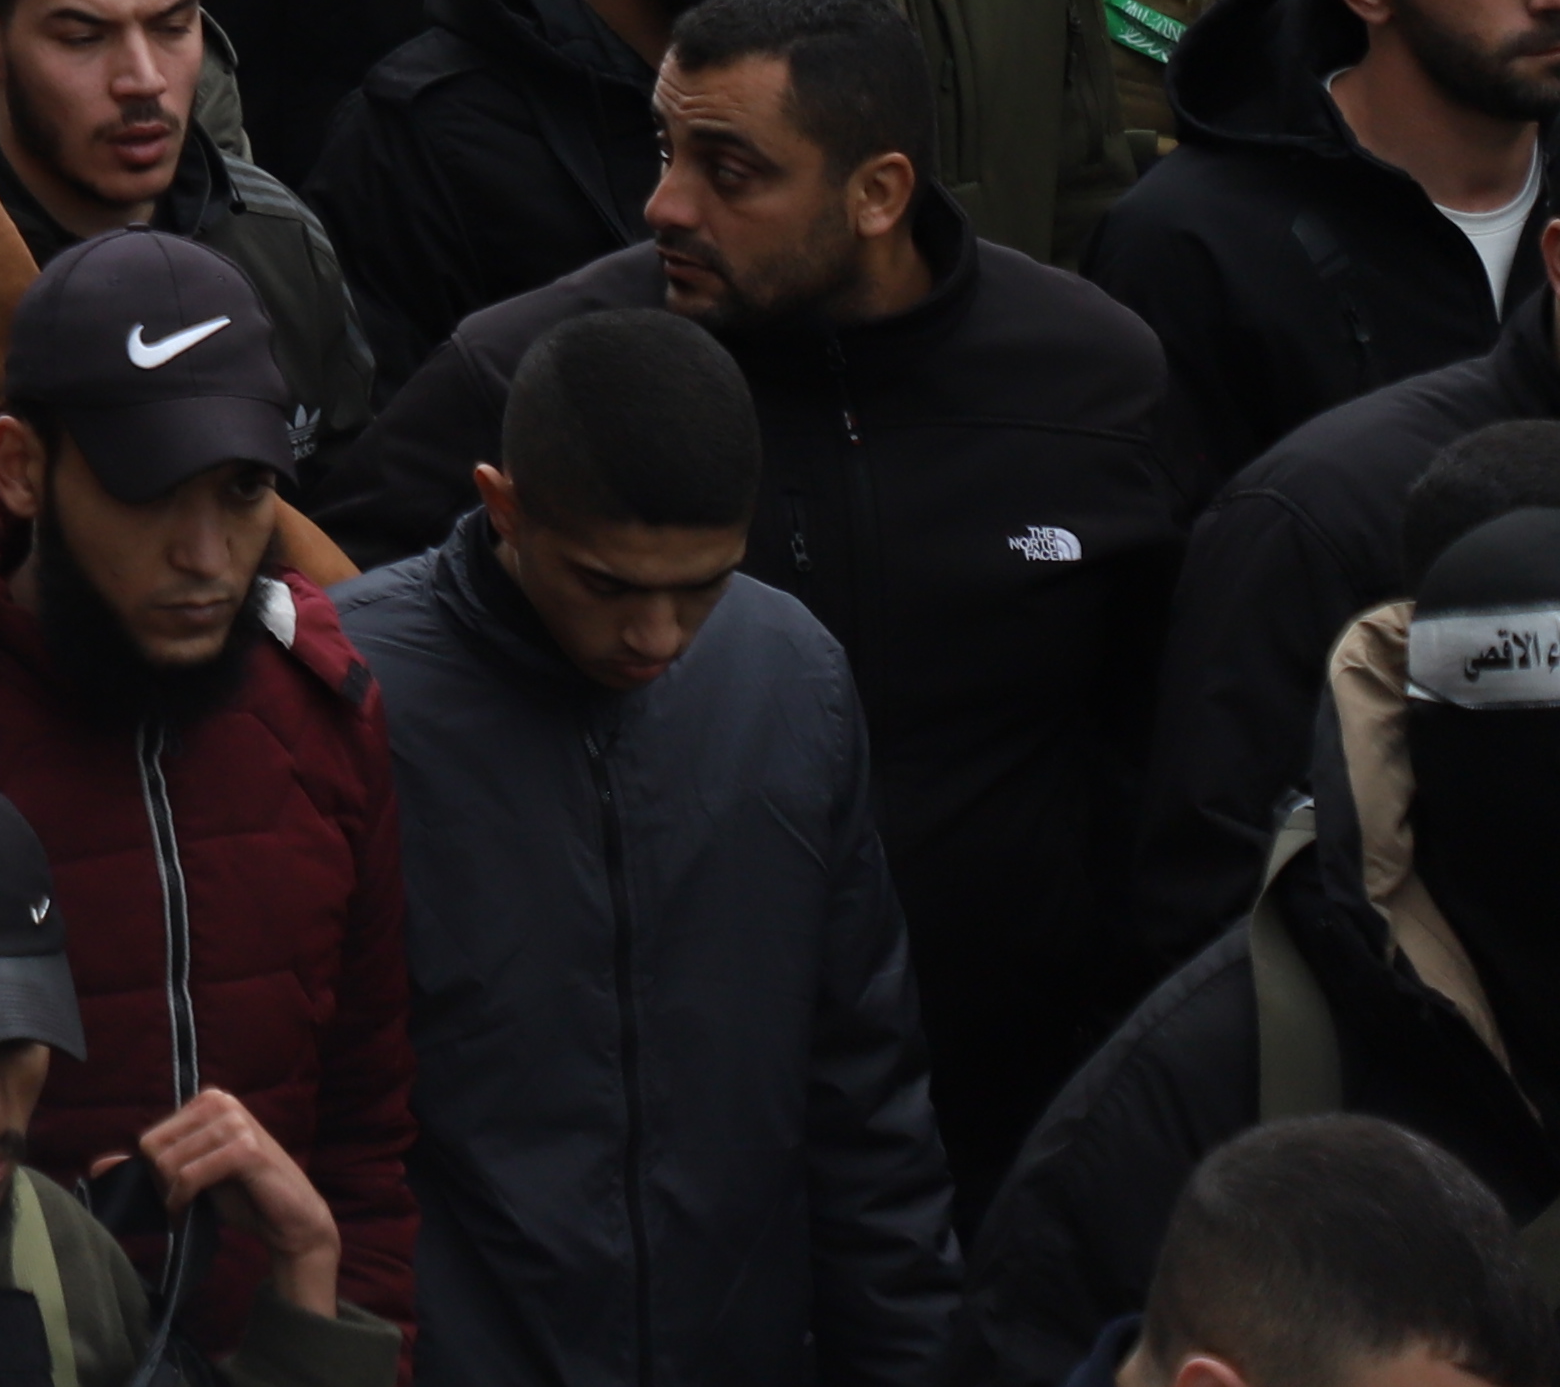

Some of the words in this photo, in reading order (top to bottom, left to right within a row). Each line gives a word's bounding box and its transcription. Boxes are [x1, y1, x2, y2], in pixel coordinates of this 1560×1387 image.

[1026, 525, 1056, 539] THE
[1007, 537, 1058, 552] NORTH
[1023, 549, 1061, 562] FACE
